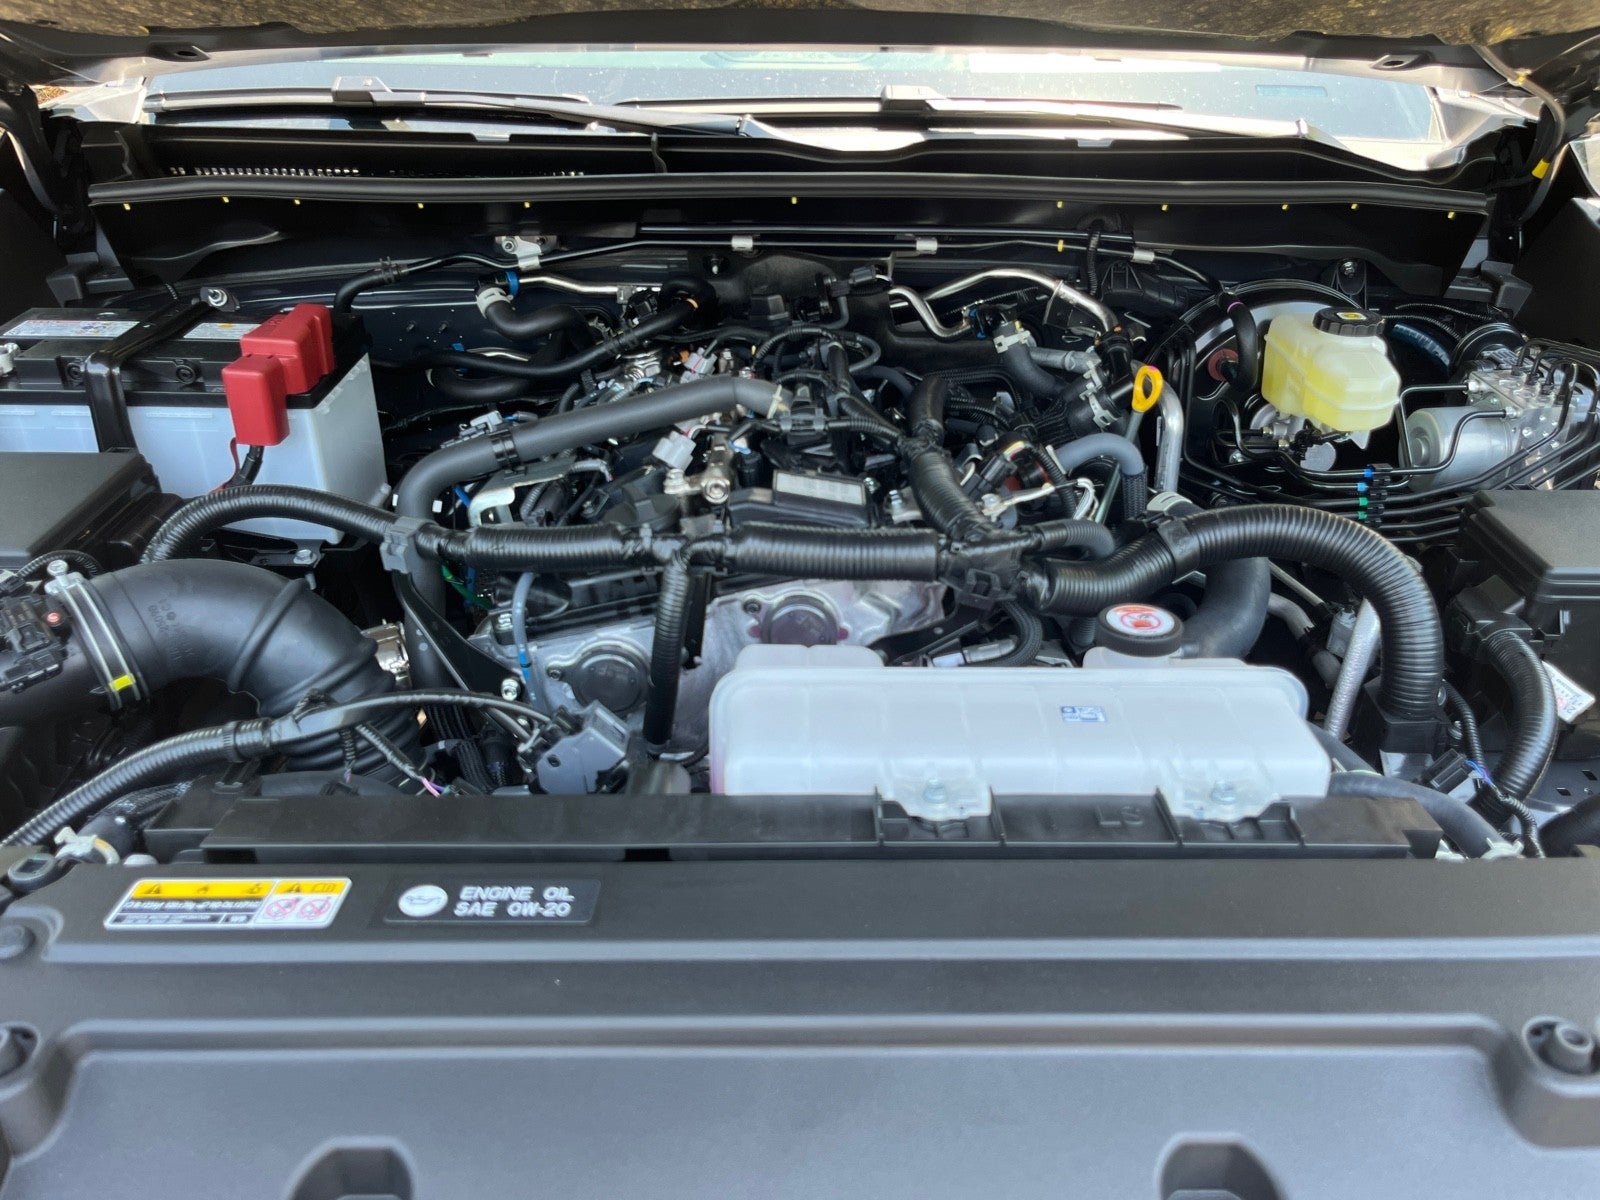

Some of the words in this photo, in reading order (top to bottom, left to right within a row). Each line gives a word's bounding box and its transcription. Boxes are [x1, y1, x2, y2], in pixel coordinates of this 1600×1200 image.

[459, 885, 534, 901] ENGINE
[542, 886, 575, 902] OIL
[453, 901, 499, 917] SAE
[507, 901, 572, 918] 0W-20
